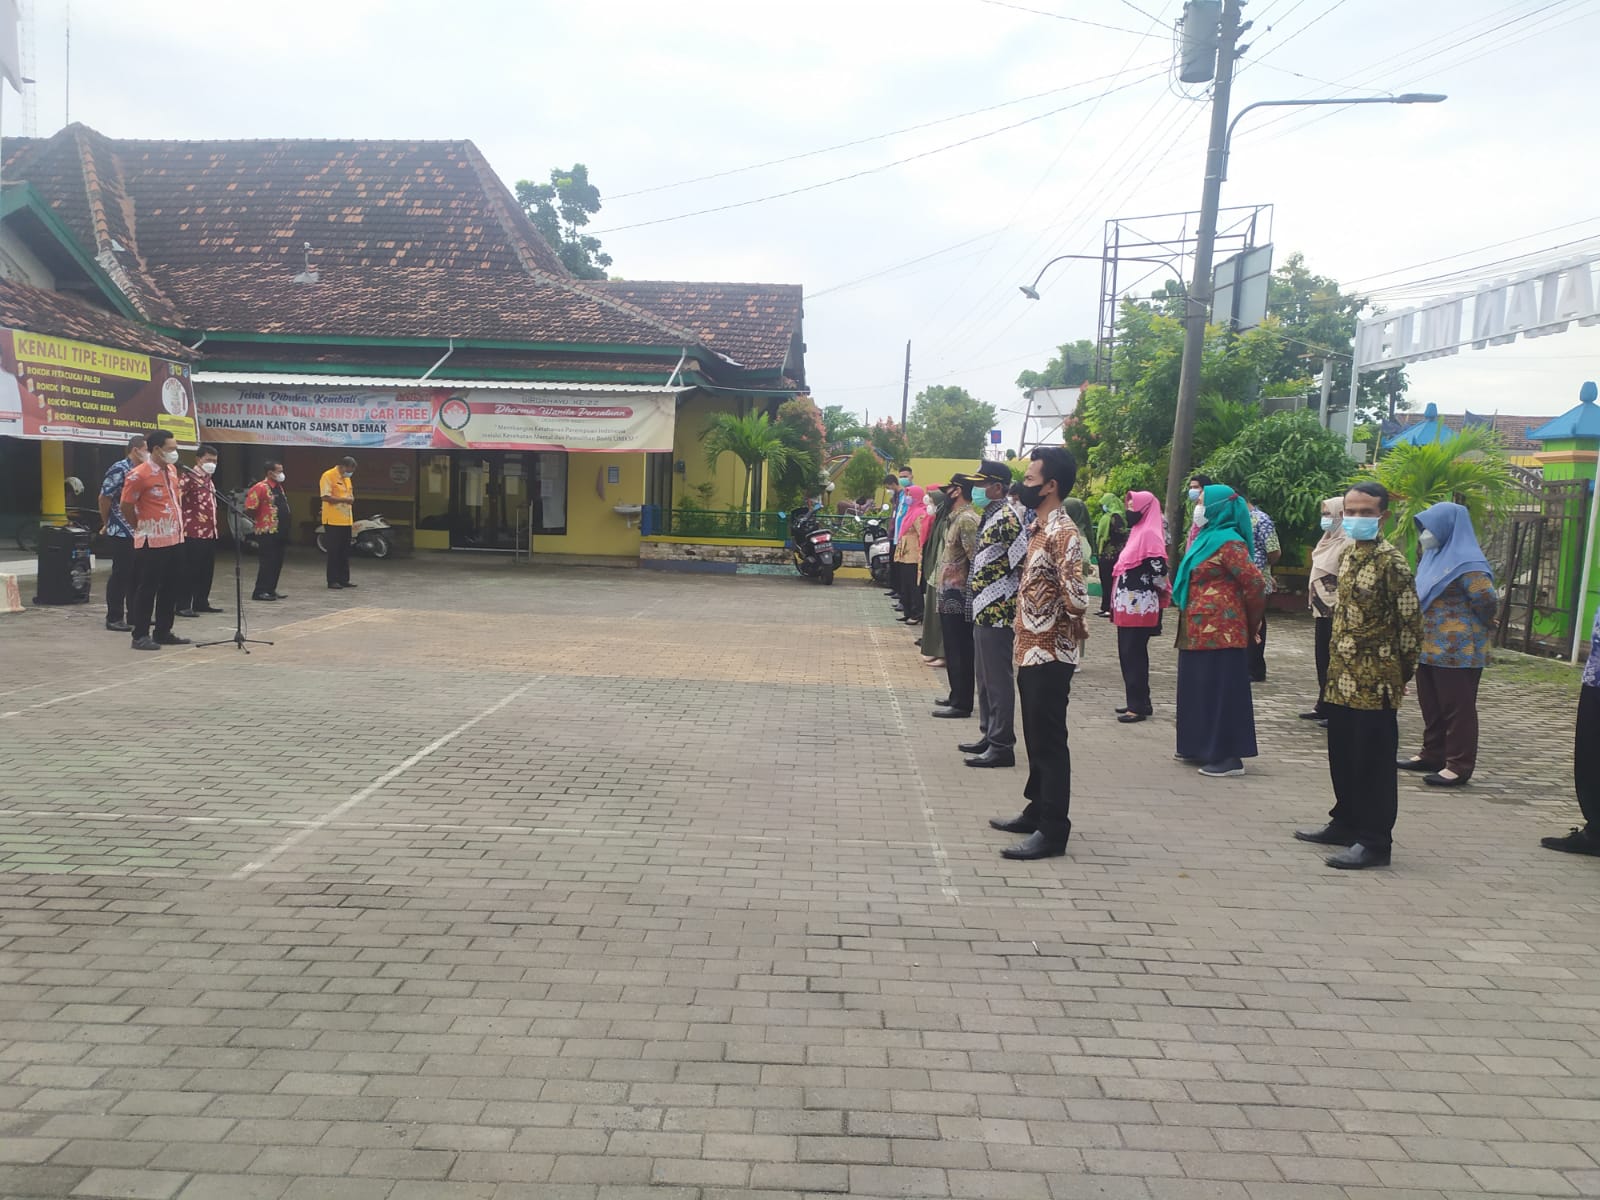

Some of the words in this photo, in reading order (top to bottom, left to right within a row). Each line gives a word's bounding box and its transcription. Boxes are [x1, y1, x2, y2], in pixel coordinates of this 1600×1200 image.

[18, 338, 67, 361] KENALI
[72, 347, 148, 375] TIPE-TIPENYA
[27, 366, 50, 377] ROKOK
[65, 371, 82, 381] CUKAI
[84, 374, 101, 384] PALSU
[36, 382, 58, 392] ROKOK
[72, 386, 90, 395] CUKAI
[313, 393, 358, 404] Kembali
[100, 404, 117, 413] BEKAS
[197, 402, 244, 415] SAMSAT
[246, 403, 288, 417] MALAM
[291, 405, 315, 418] DAN
[320, 406, 367, 419] SAMSAT
[370, 408, 394, 420] CAR
[398, 408, 428, 420] FREE
[494, 404, 536, 415] Dharma
[577, 407, 625, 417] Persatuan
[54, 412, 75, 422] ROKOK
[76, 415, 95, 424] POLOS
[205, 418, 263, 429] DIHALAMAN
[266, 420, 306, 431] KANTOR
[309, 422, 349, 433] SAMSAT
[352, 423, 387, 433] DEMAK
